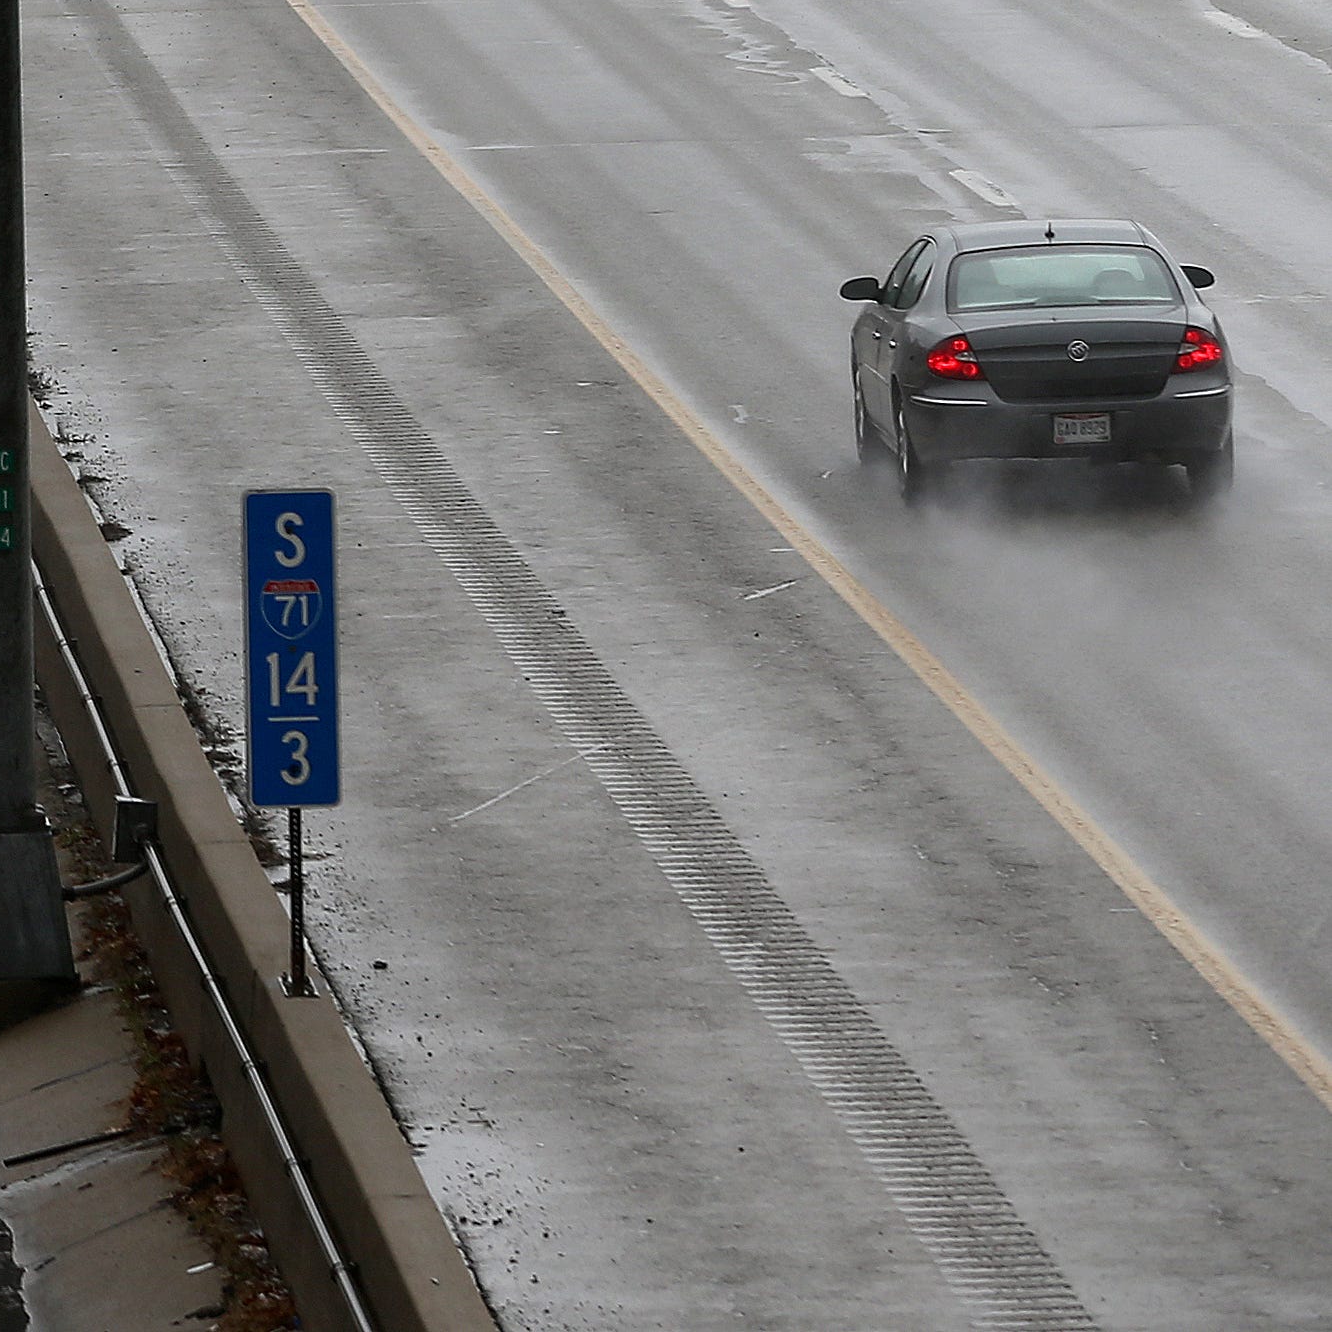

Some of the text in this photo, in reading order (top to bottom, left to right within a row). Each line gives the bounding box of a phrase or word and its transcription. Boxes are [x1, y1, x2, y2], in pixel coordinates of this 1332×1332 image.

[274, 512, 306, 568] S
[274, 595, 309, 626] 71
[265, 651, 320, 707] 14
[280, 730, 312, 786] 3
